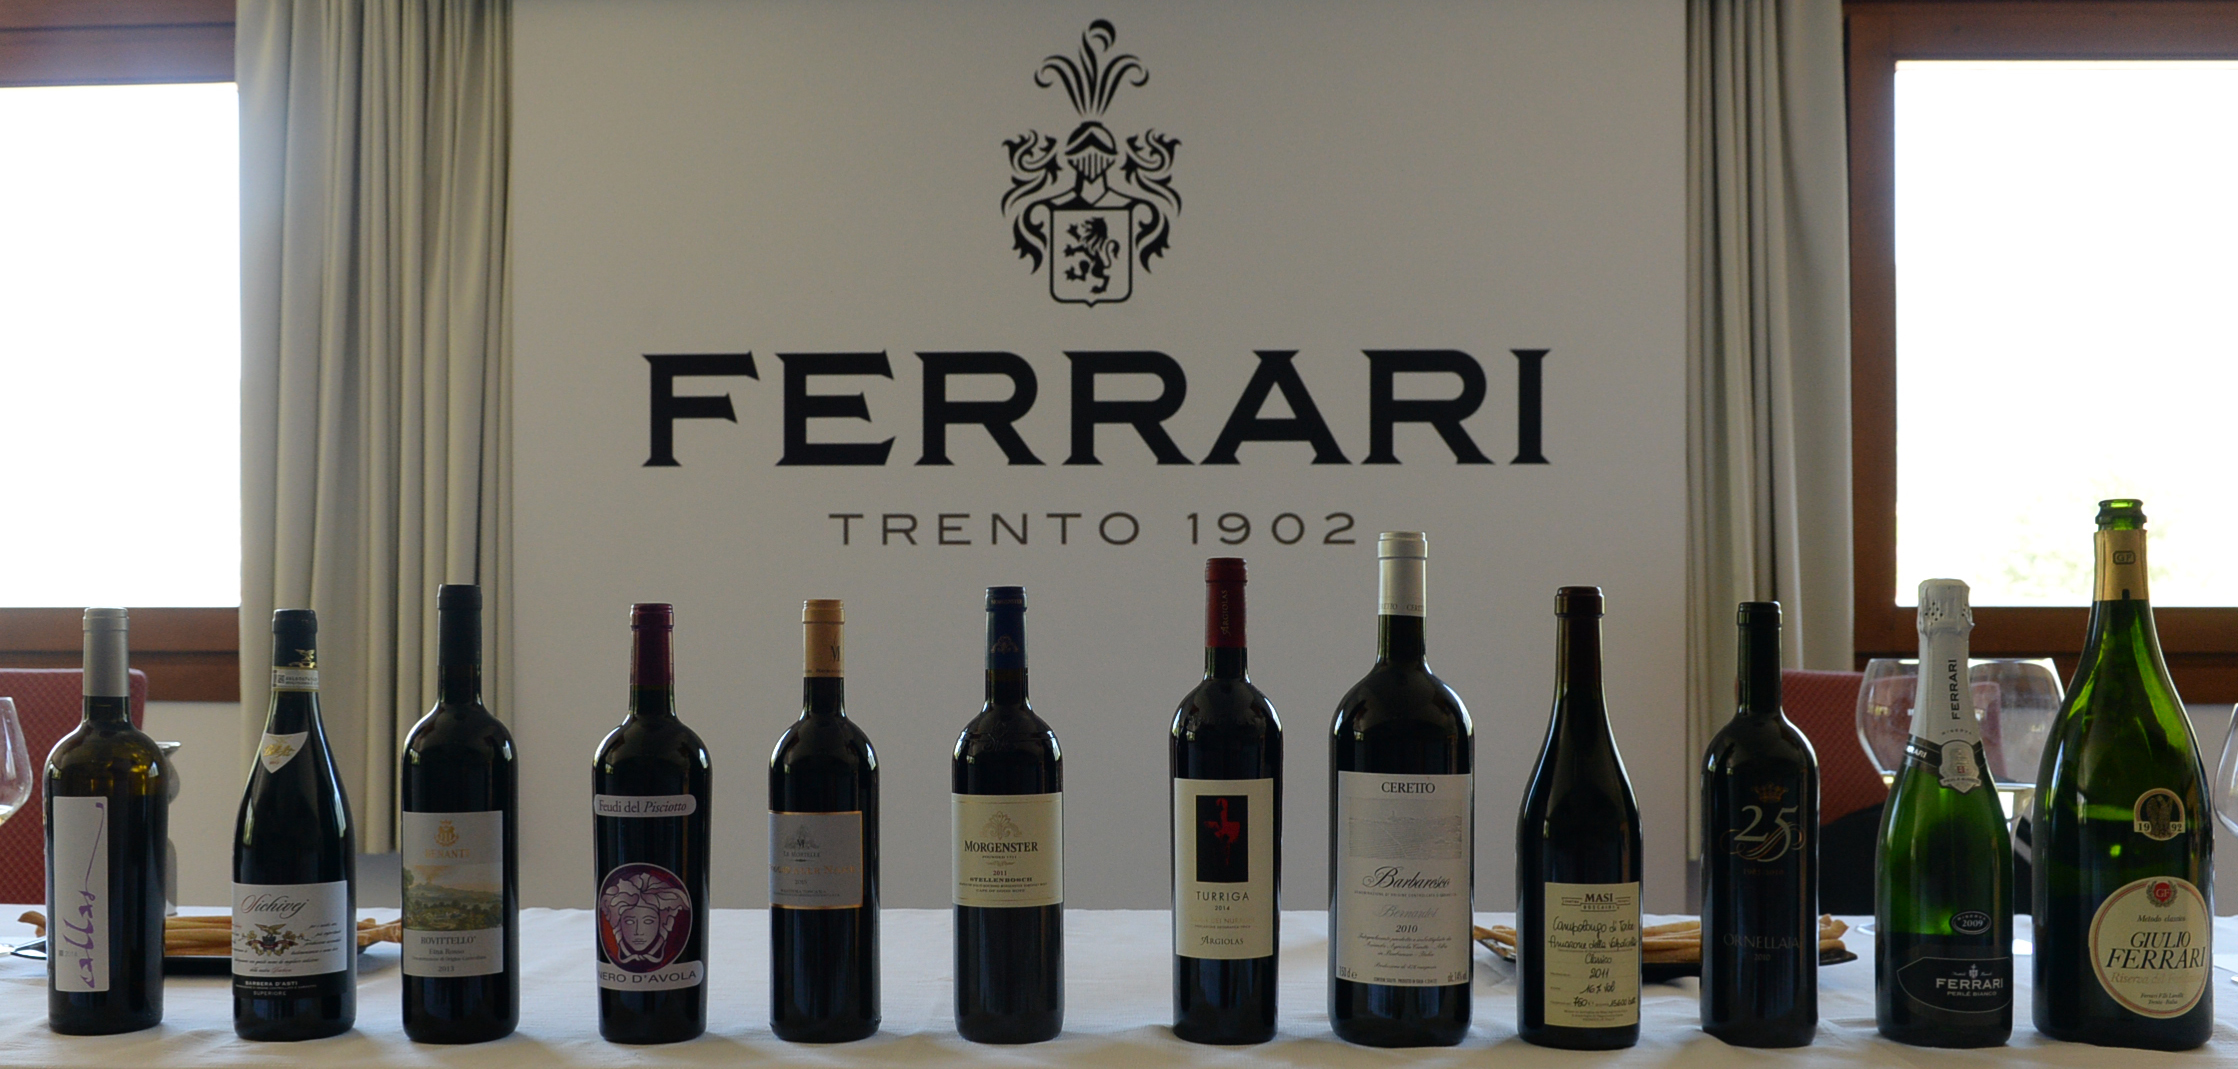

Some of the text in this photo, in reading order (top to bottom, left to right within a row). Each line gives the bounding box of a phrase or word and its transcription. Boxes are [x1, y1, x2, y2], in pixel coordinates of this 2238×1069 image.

[641, 348, 1551, 467] FERRARI
[829, 512, 1357, 546] TRENTO 1902
[1948, 659, 1961, 720] FERRARI
[1381, 781, 1436, 794] CERETTO
[599, 799, 687, 813] Feudi del Pisciotto
[1733, 804, 1799, 863] 25
[2137, 822, 2183, 833] 19 92
[964, 839, 1039, 853] MORGENSTER
[1362, 865, 1450, 889] Barbaresco
[1196, 890, 1250, 901] TURRIGA
[1584, 893, 1613, 903] MASI
[2155, 888, 2172, 899] GF
[1214, 904, 1231, 912] 2014
[1962, 919, 1984, 928] 2009
[2137, 914, 2162, 923] Metodo
[1396, 924, 1418, 934] 2010
[1200, 934, 1244, 946] ARGIOLAS
[1723, 932, 1801, 950] ORNELLAIA
[2130, 931, 2192, 949] GIULIO
[2105, 946, 2206, 970] FERRARI
[598, 969, 697, 984] NERO D'AVOLA
[1589, 967, 1610, 979] 2011
[1936, 977, 2004, 990] FERRARI
